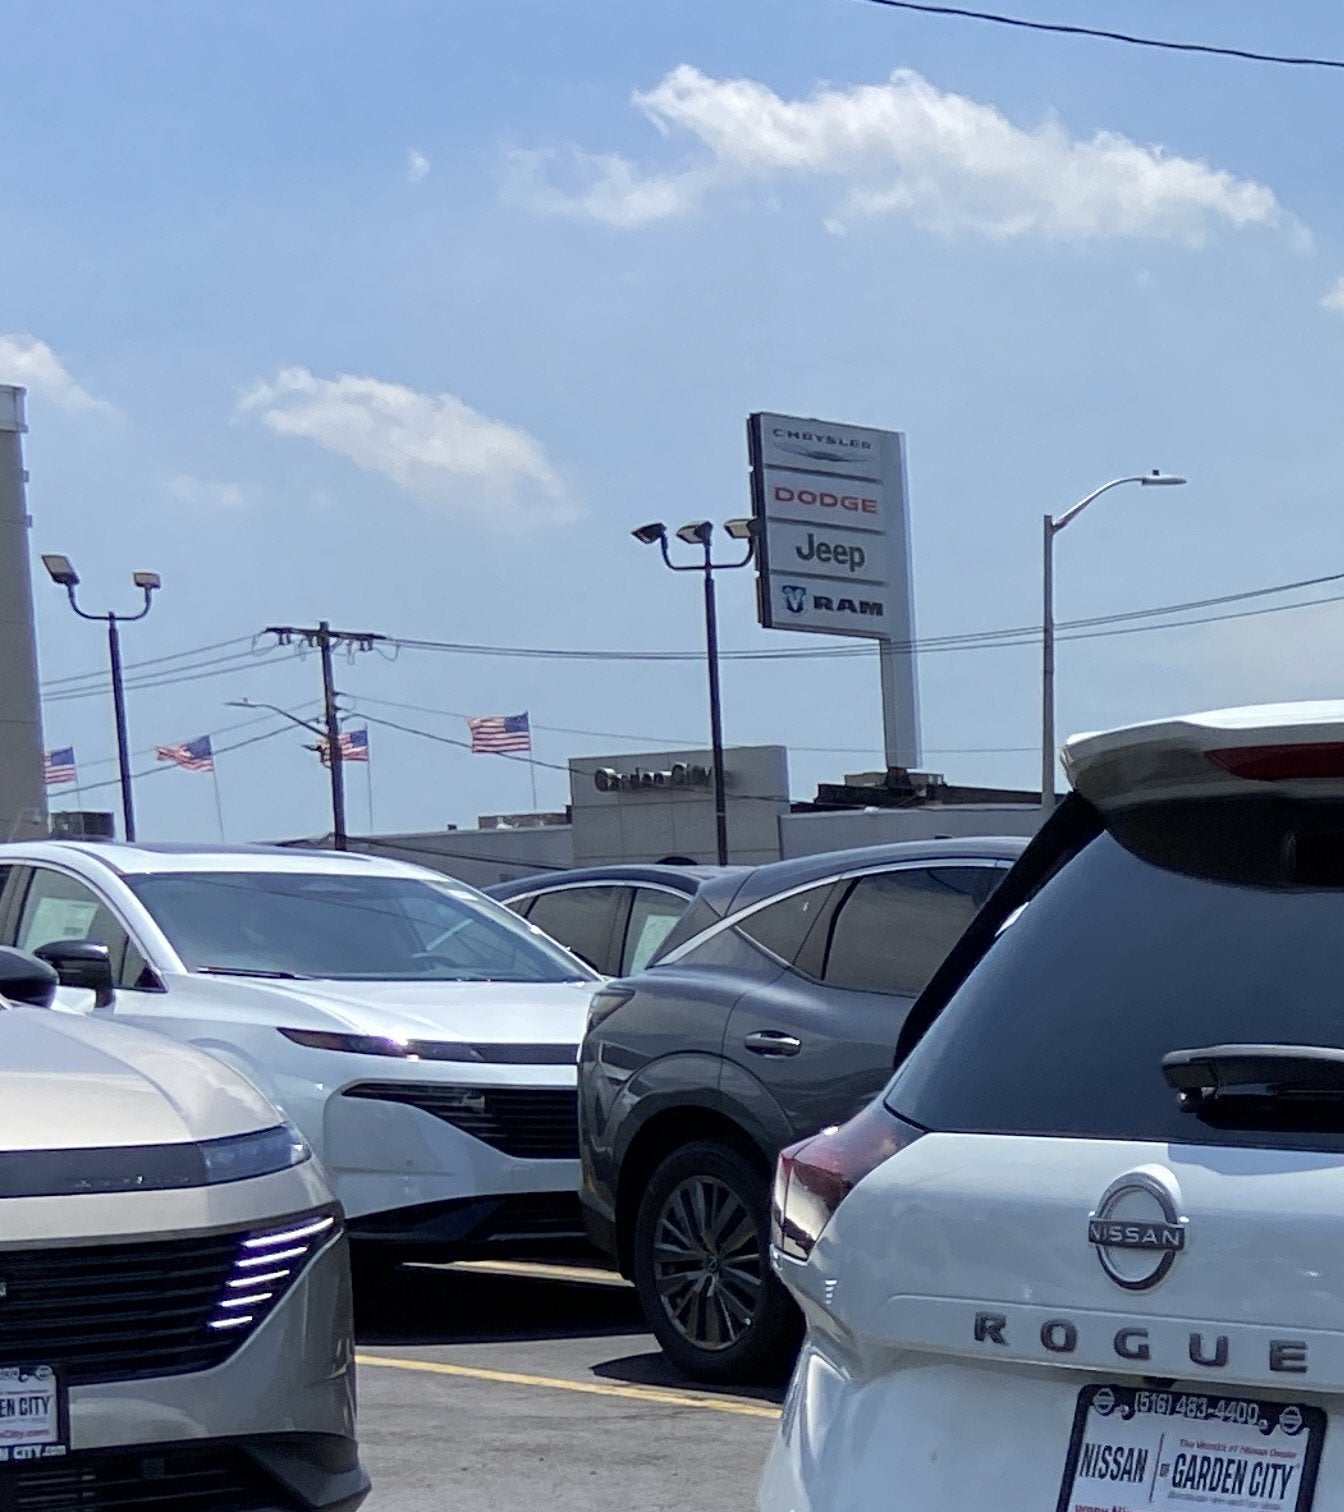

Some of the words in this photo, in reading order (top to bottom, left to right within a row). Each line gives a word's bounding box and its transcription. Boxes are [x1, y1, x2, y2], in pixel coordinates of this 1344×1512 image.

[773, 428, 871, 449] CHRYSLER
[774, 487, 877, 514] DODGE
[796, 533, 865, 572] Jeep
[813, 595, 884, 616] RAM
[1090, 1222, 1181, 1247] NISSAN
[974, 1311, 1309, 1374] ROGUE
[20, 1396, 51, 1416] CITY
[1175, 1395, 1260, 1424] 483-4400
[1079, 1442, 1149, 1482] NISSAN
[1172, 1453, 1248, 1495] GARDEN
[1249, 1461, 1294, 1500] CITY
